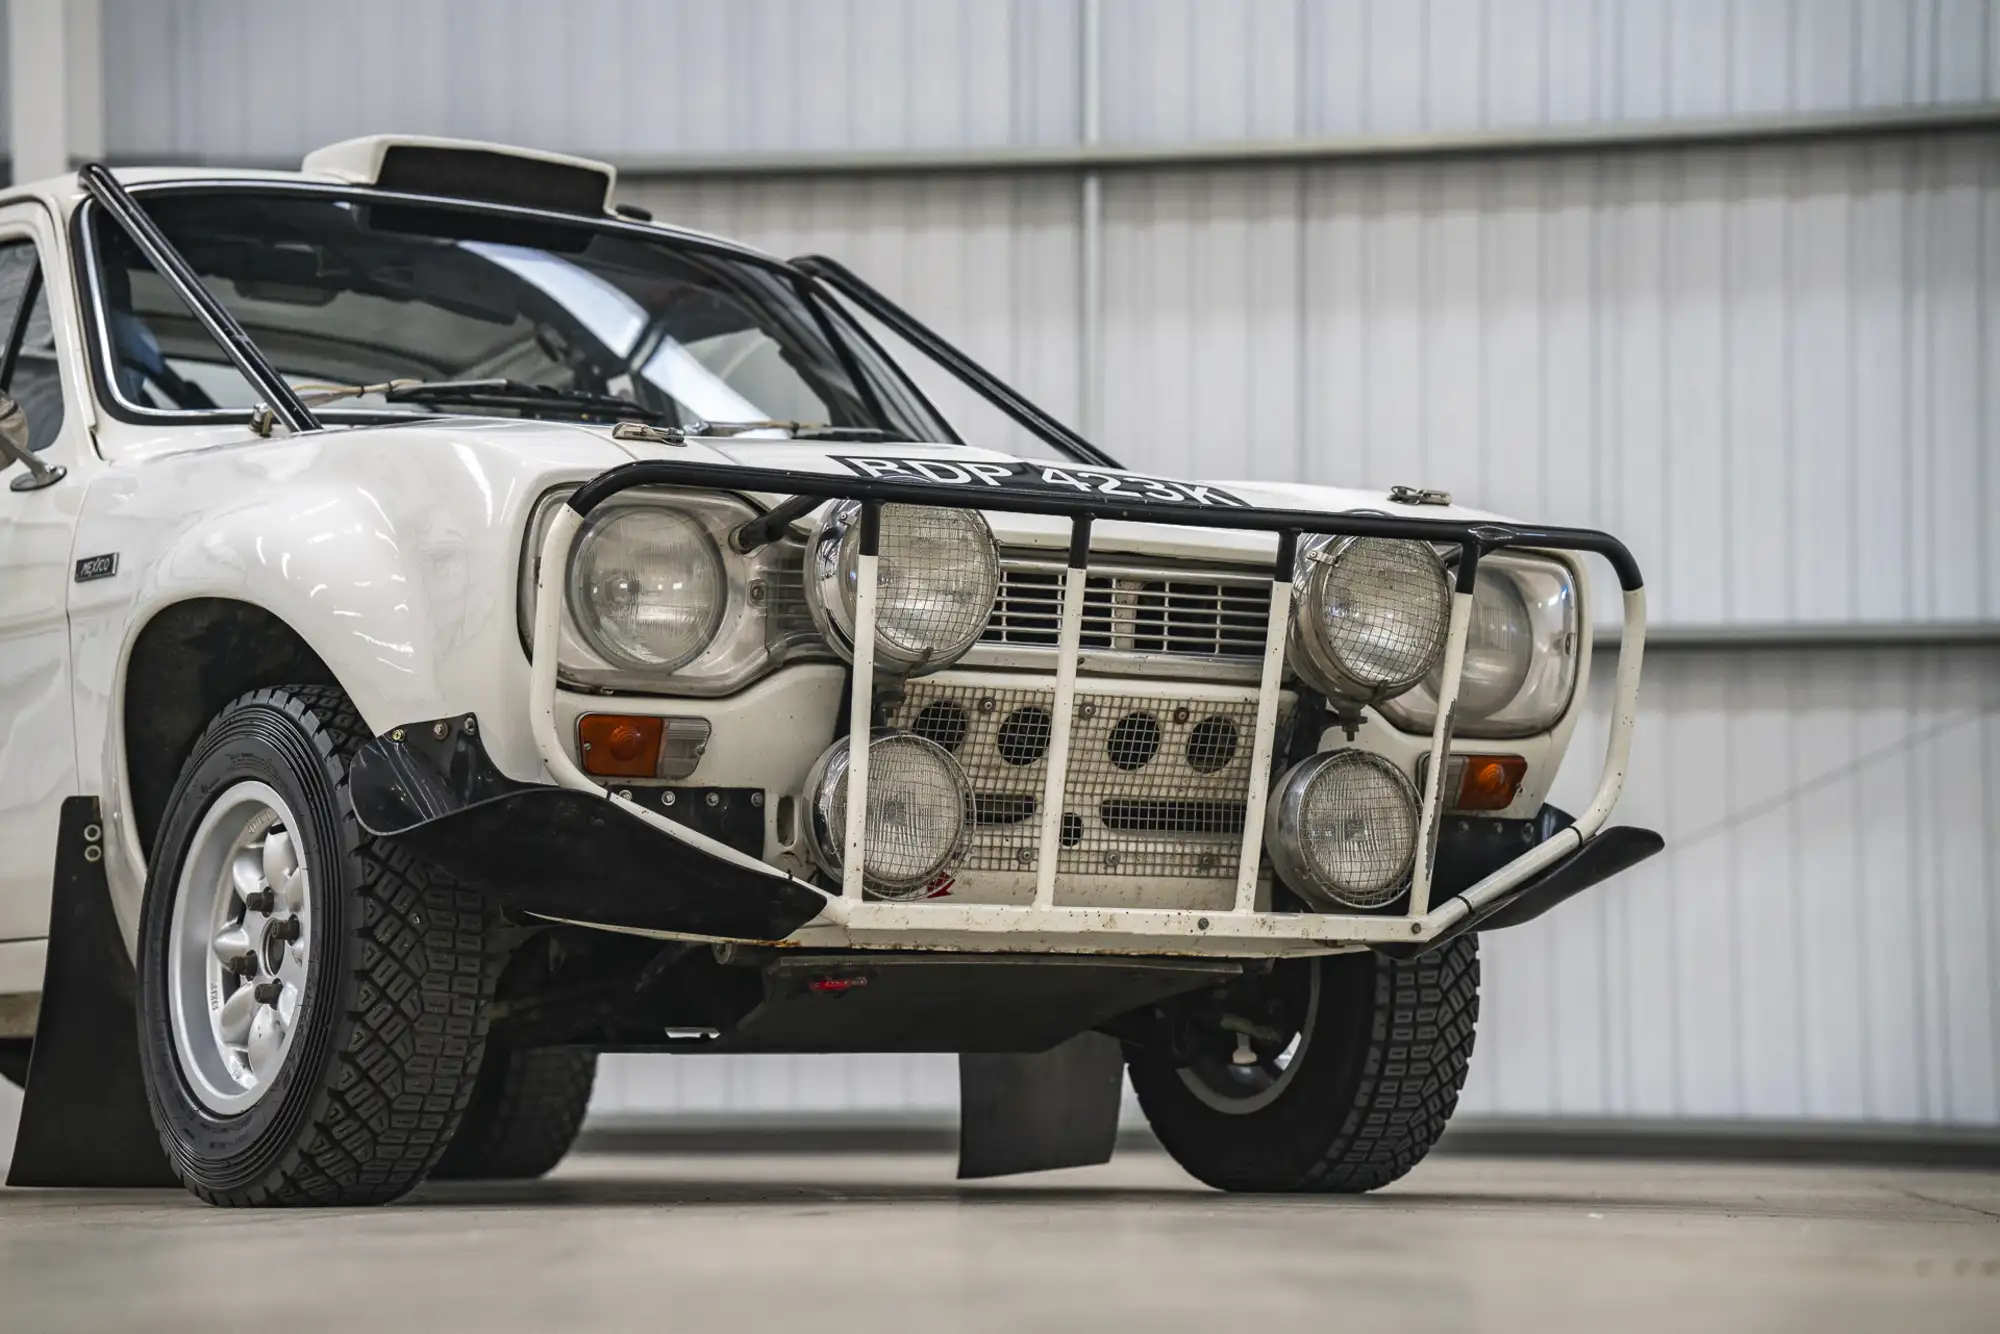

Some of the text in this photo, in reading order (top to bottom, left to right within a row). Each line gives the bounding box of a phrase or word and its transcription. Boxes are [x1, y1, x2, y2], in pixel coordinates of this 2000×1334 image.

[845, 458, 1244, 508] RDP 423K
[80, 557, 110, 577] MEXICO
